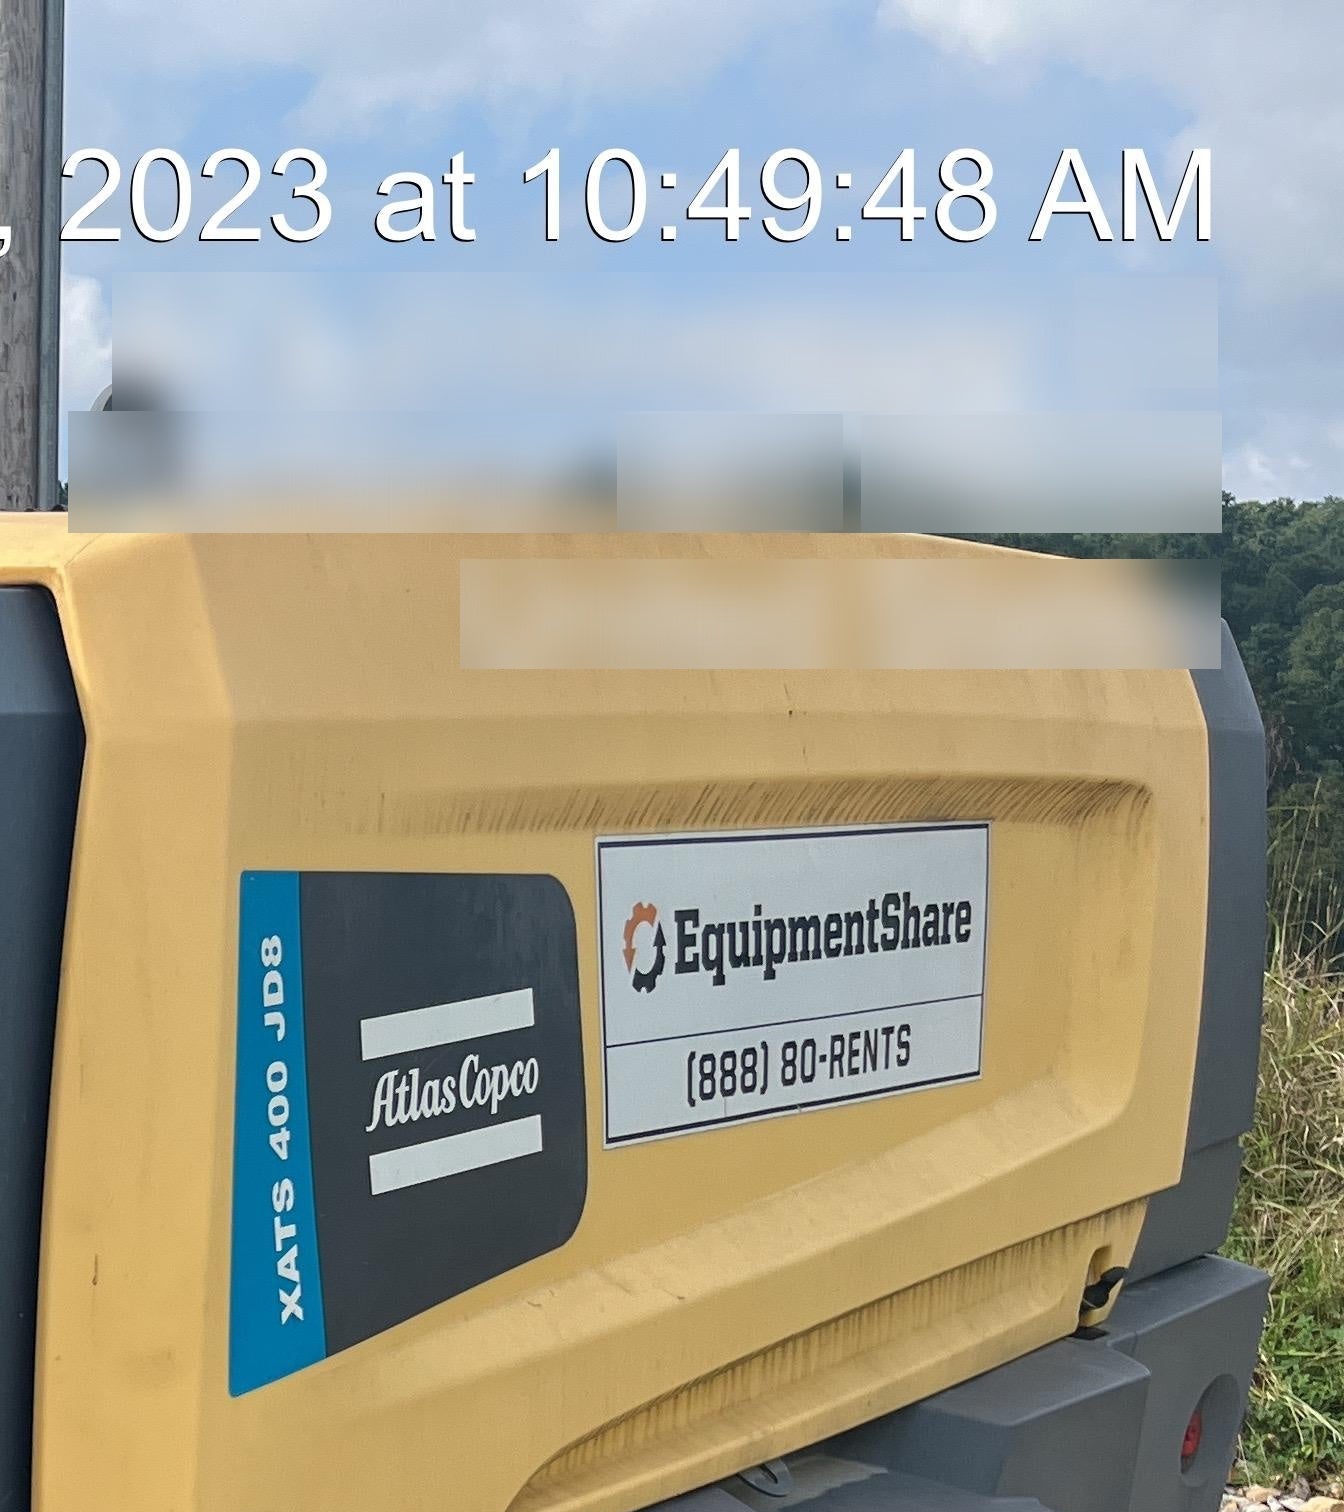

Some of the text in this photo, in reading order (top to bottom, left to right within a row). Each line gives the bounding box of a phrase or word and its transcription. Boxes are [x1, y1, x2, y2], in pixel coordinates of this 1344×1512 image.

[673, 890, 973, 987] EquipmentShare
[364, 1053, 540, 1133] Atlas Copco
[686, 1022, 912, 1107] (888) 80-RENTS
[260, 933, 304, 1325] XATS 400 JD8
